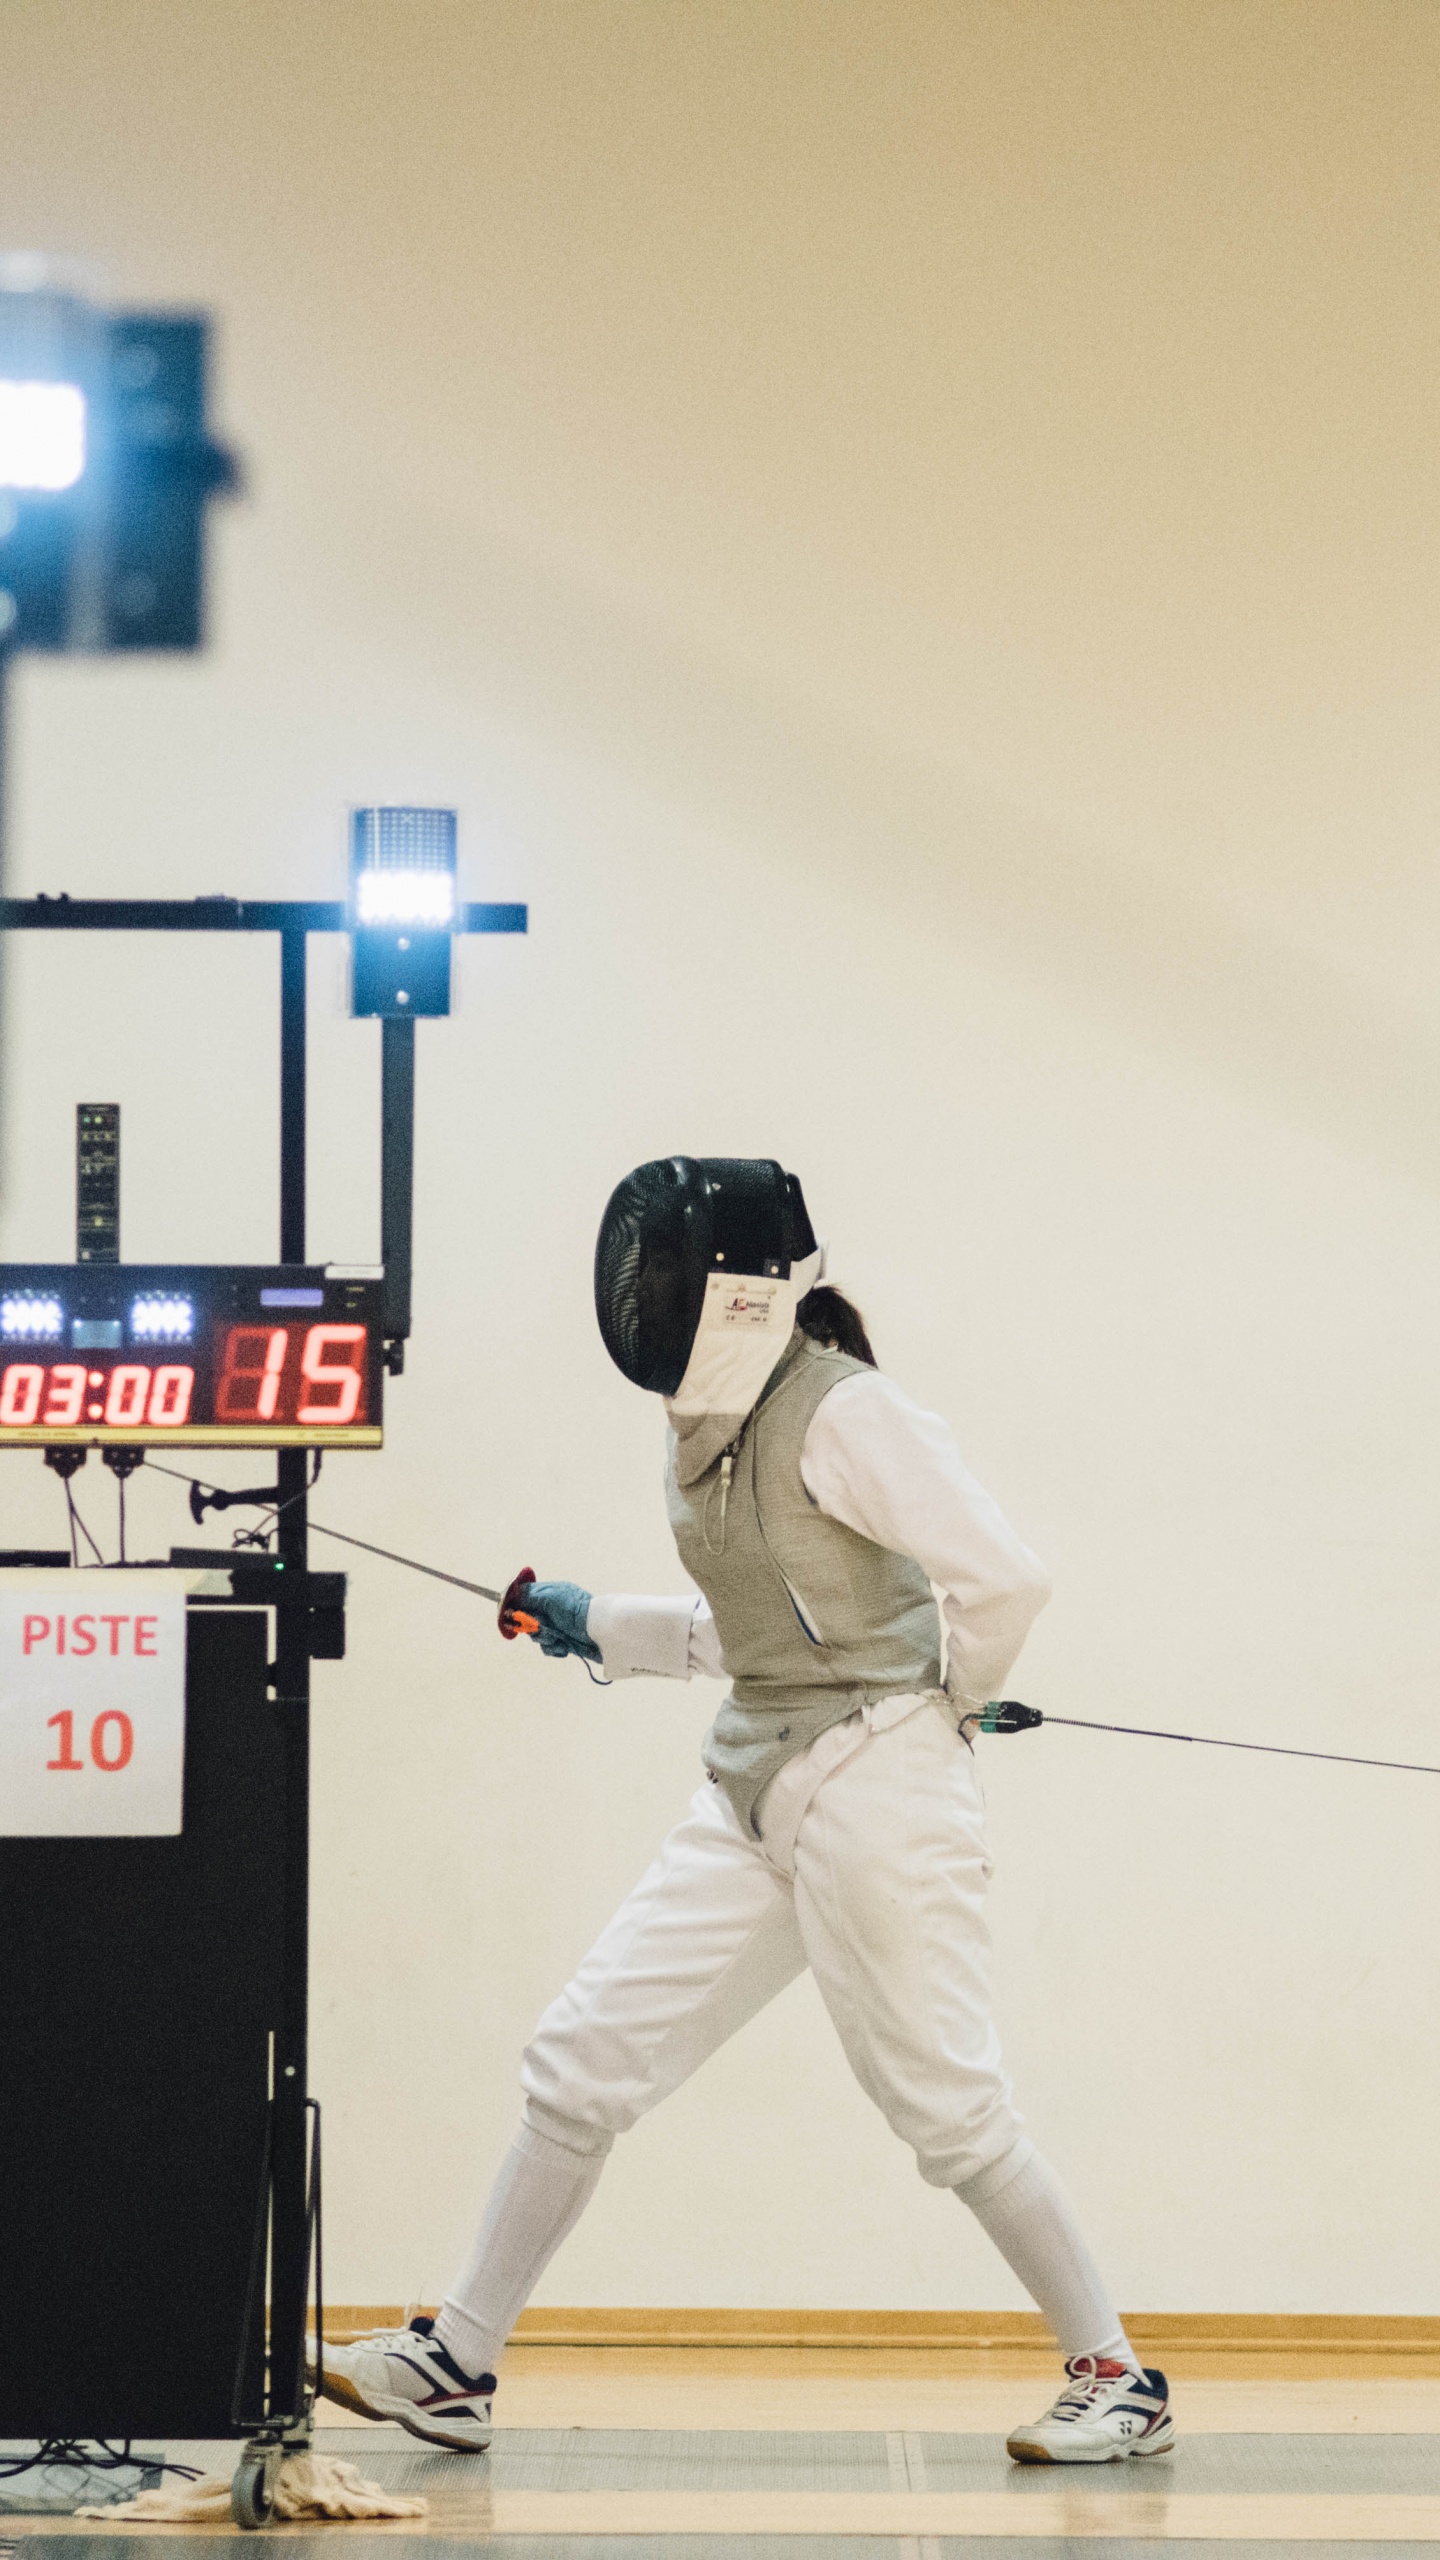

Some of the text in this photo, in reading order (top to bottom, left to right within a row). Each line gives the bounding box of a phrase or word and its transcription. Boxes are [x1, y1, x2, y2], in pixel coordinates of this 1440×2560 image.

[0, 1364, 194, 1425] 03:00
[257, 1324, 367, 1424] 15
[22, 1614, 158, 1656] PISTE
[46, 1709, 134, 1771] 10
